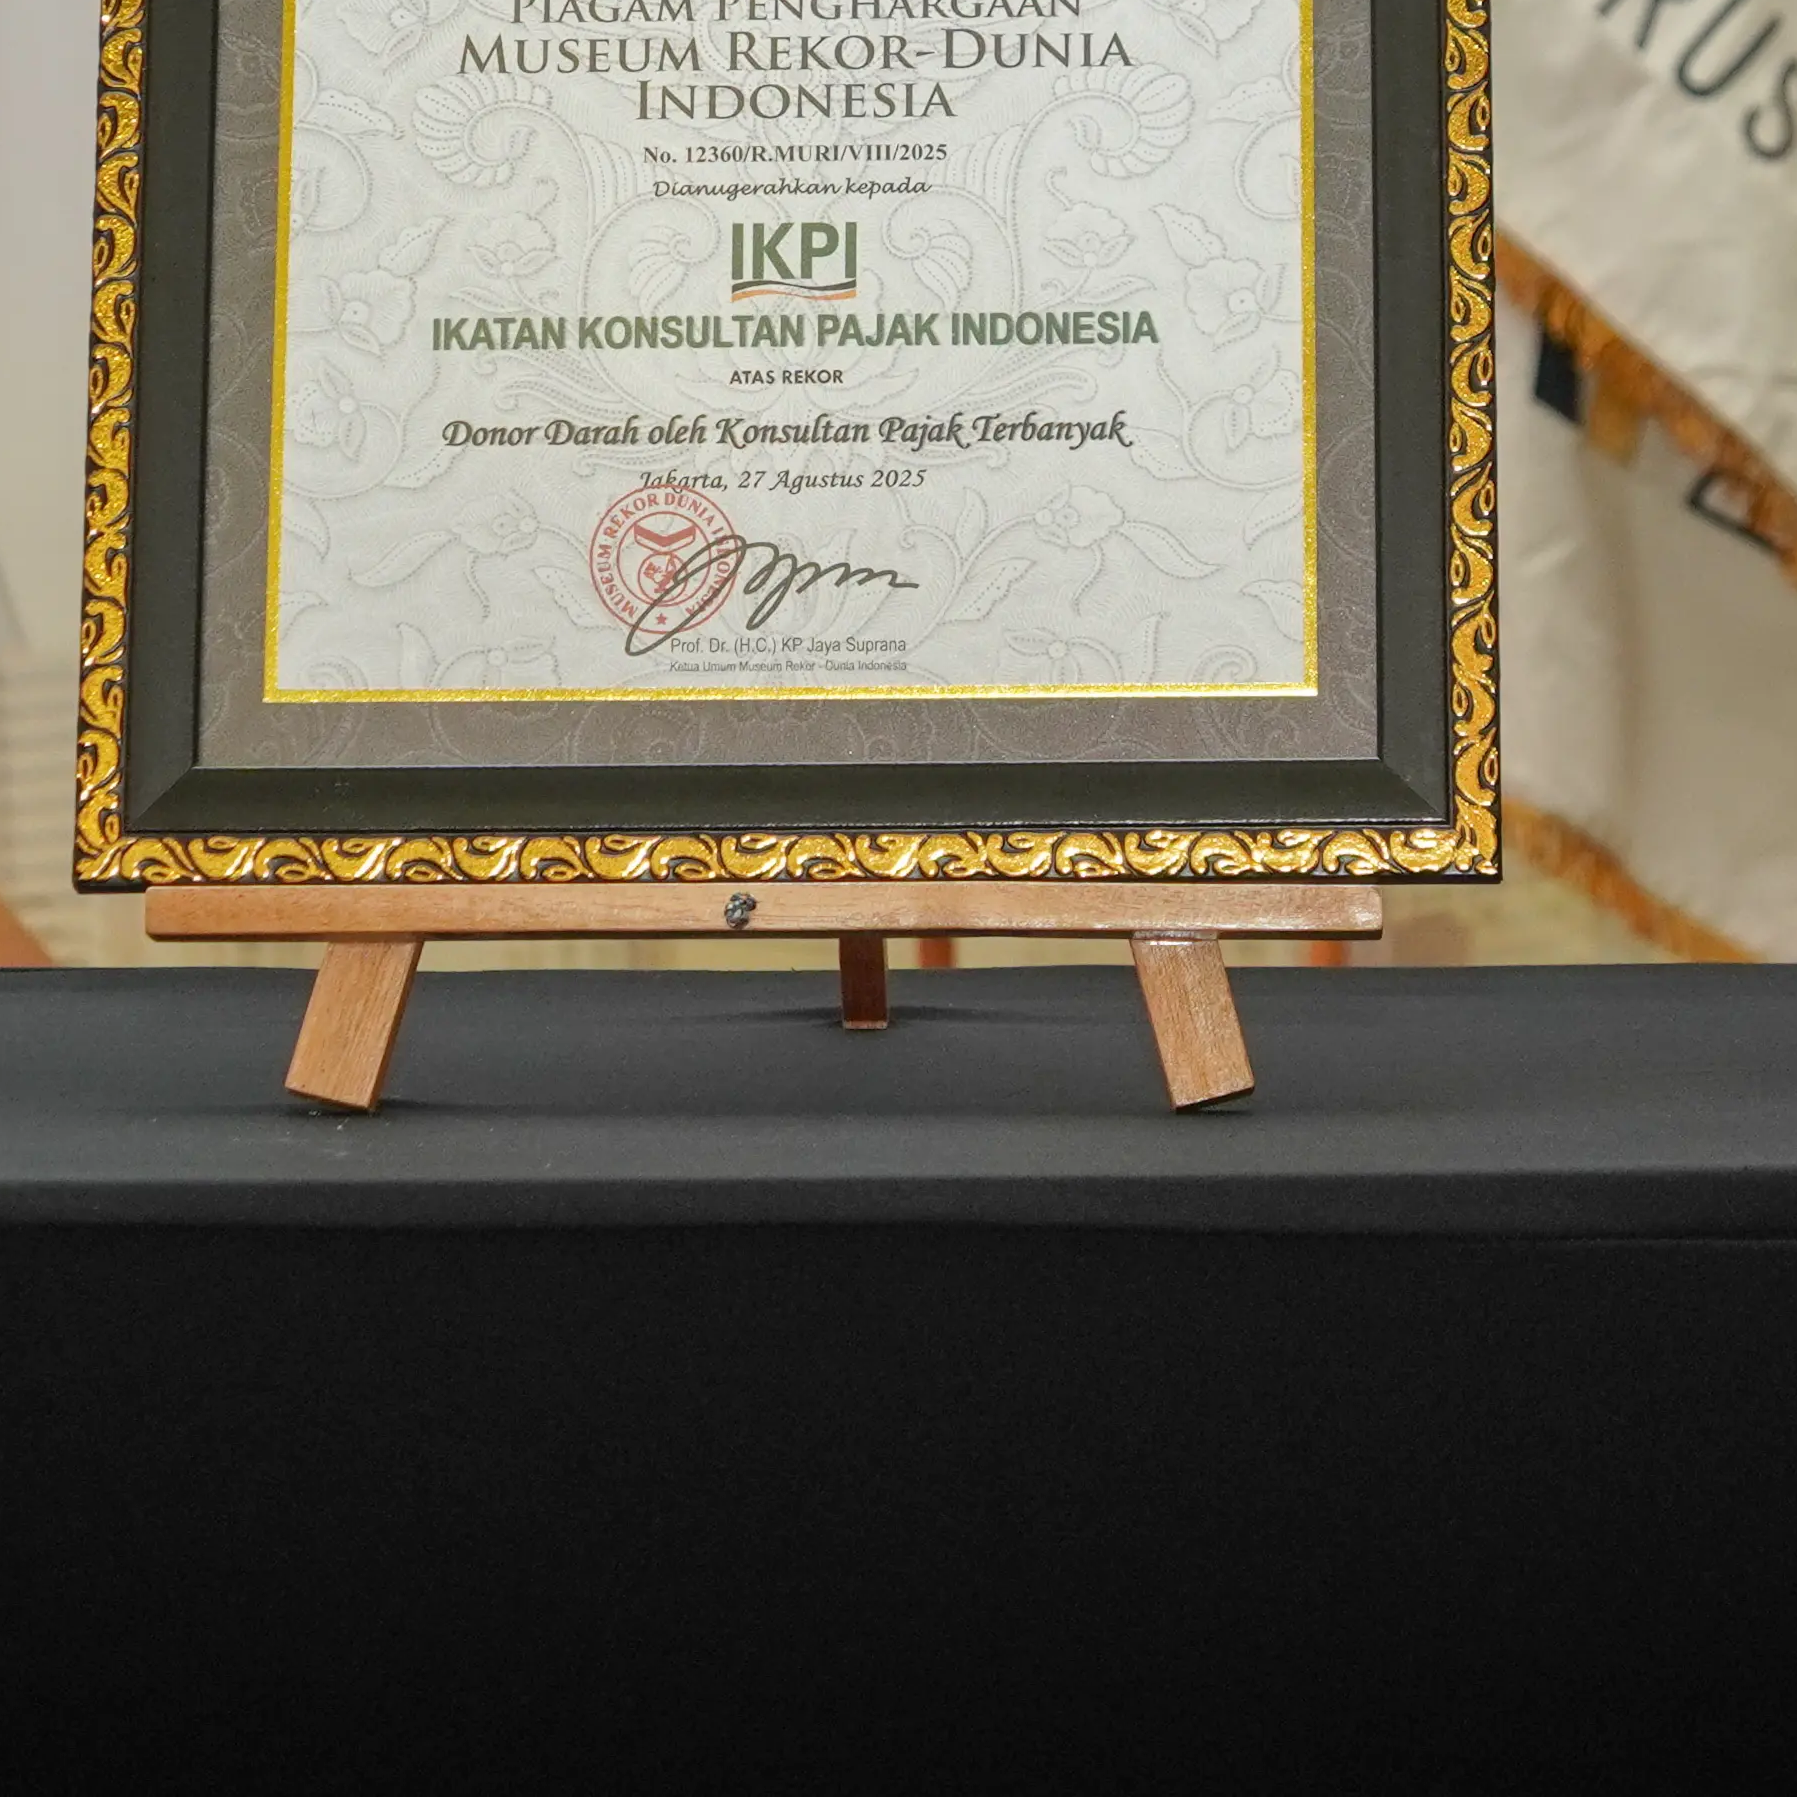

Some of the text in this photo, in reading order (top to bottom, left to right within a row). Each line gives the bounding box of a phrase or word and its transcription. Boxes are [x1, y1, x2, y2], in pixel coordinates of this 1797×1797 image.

[643, 143, 948, 164] No. 12360/R.MURI/VIII/2025
[652, 176, 933, 202] Dianugerahkan kepada
[731, 222, 859, 282] IKPI
[432, 310, 1160, 351] IKATAN KONSULTAN PAJAK INDONESIA
[729, 368, 844, 386] ATAS REKOR
[441, 409, 1134, 453] Donor Darah oleh Konsultan Pajak Terbanyak
[639, 467, 928, 494] Jakarta, 27 Agustus 2025
[603, 493, 660, 539] REKOR
[664, 492, 715, 526] DUNIA
[597, 544, 638, 618] MUSEUM
[671, 637, 907, 655] Prof. Dr. (H.C.) KP Jaya Suprana
[703, 661, 736, 672] Umum
[739, 661, 782, 672] Museum
